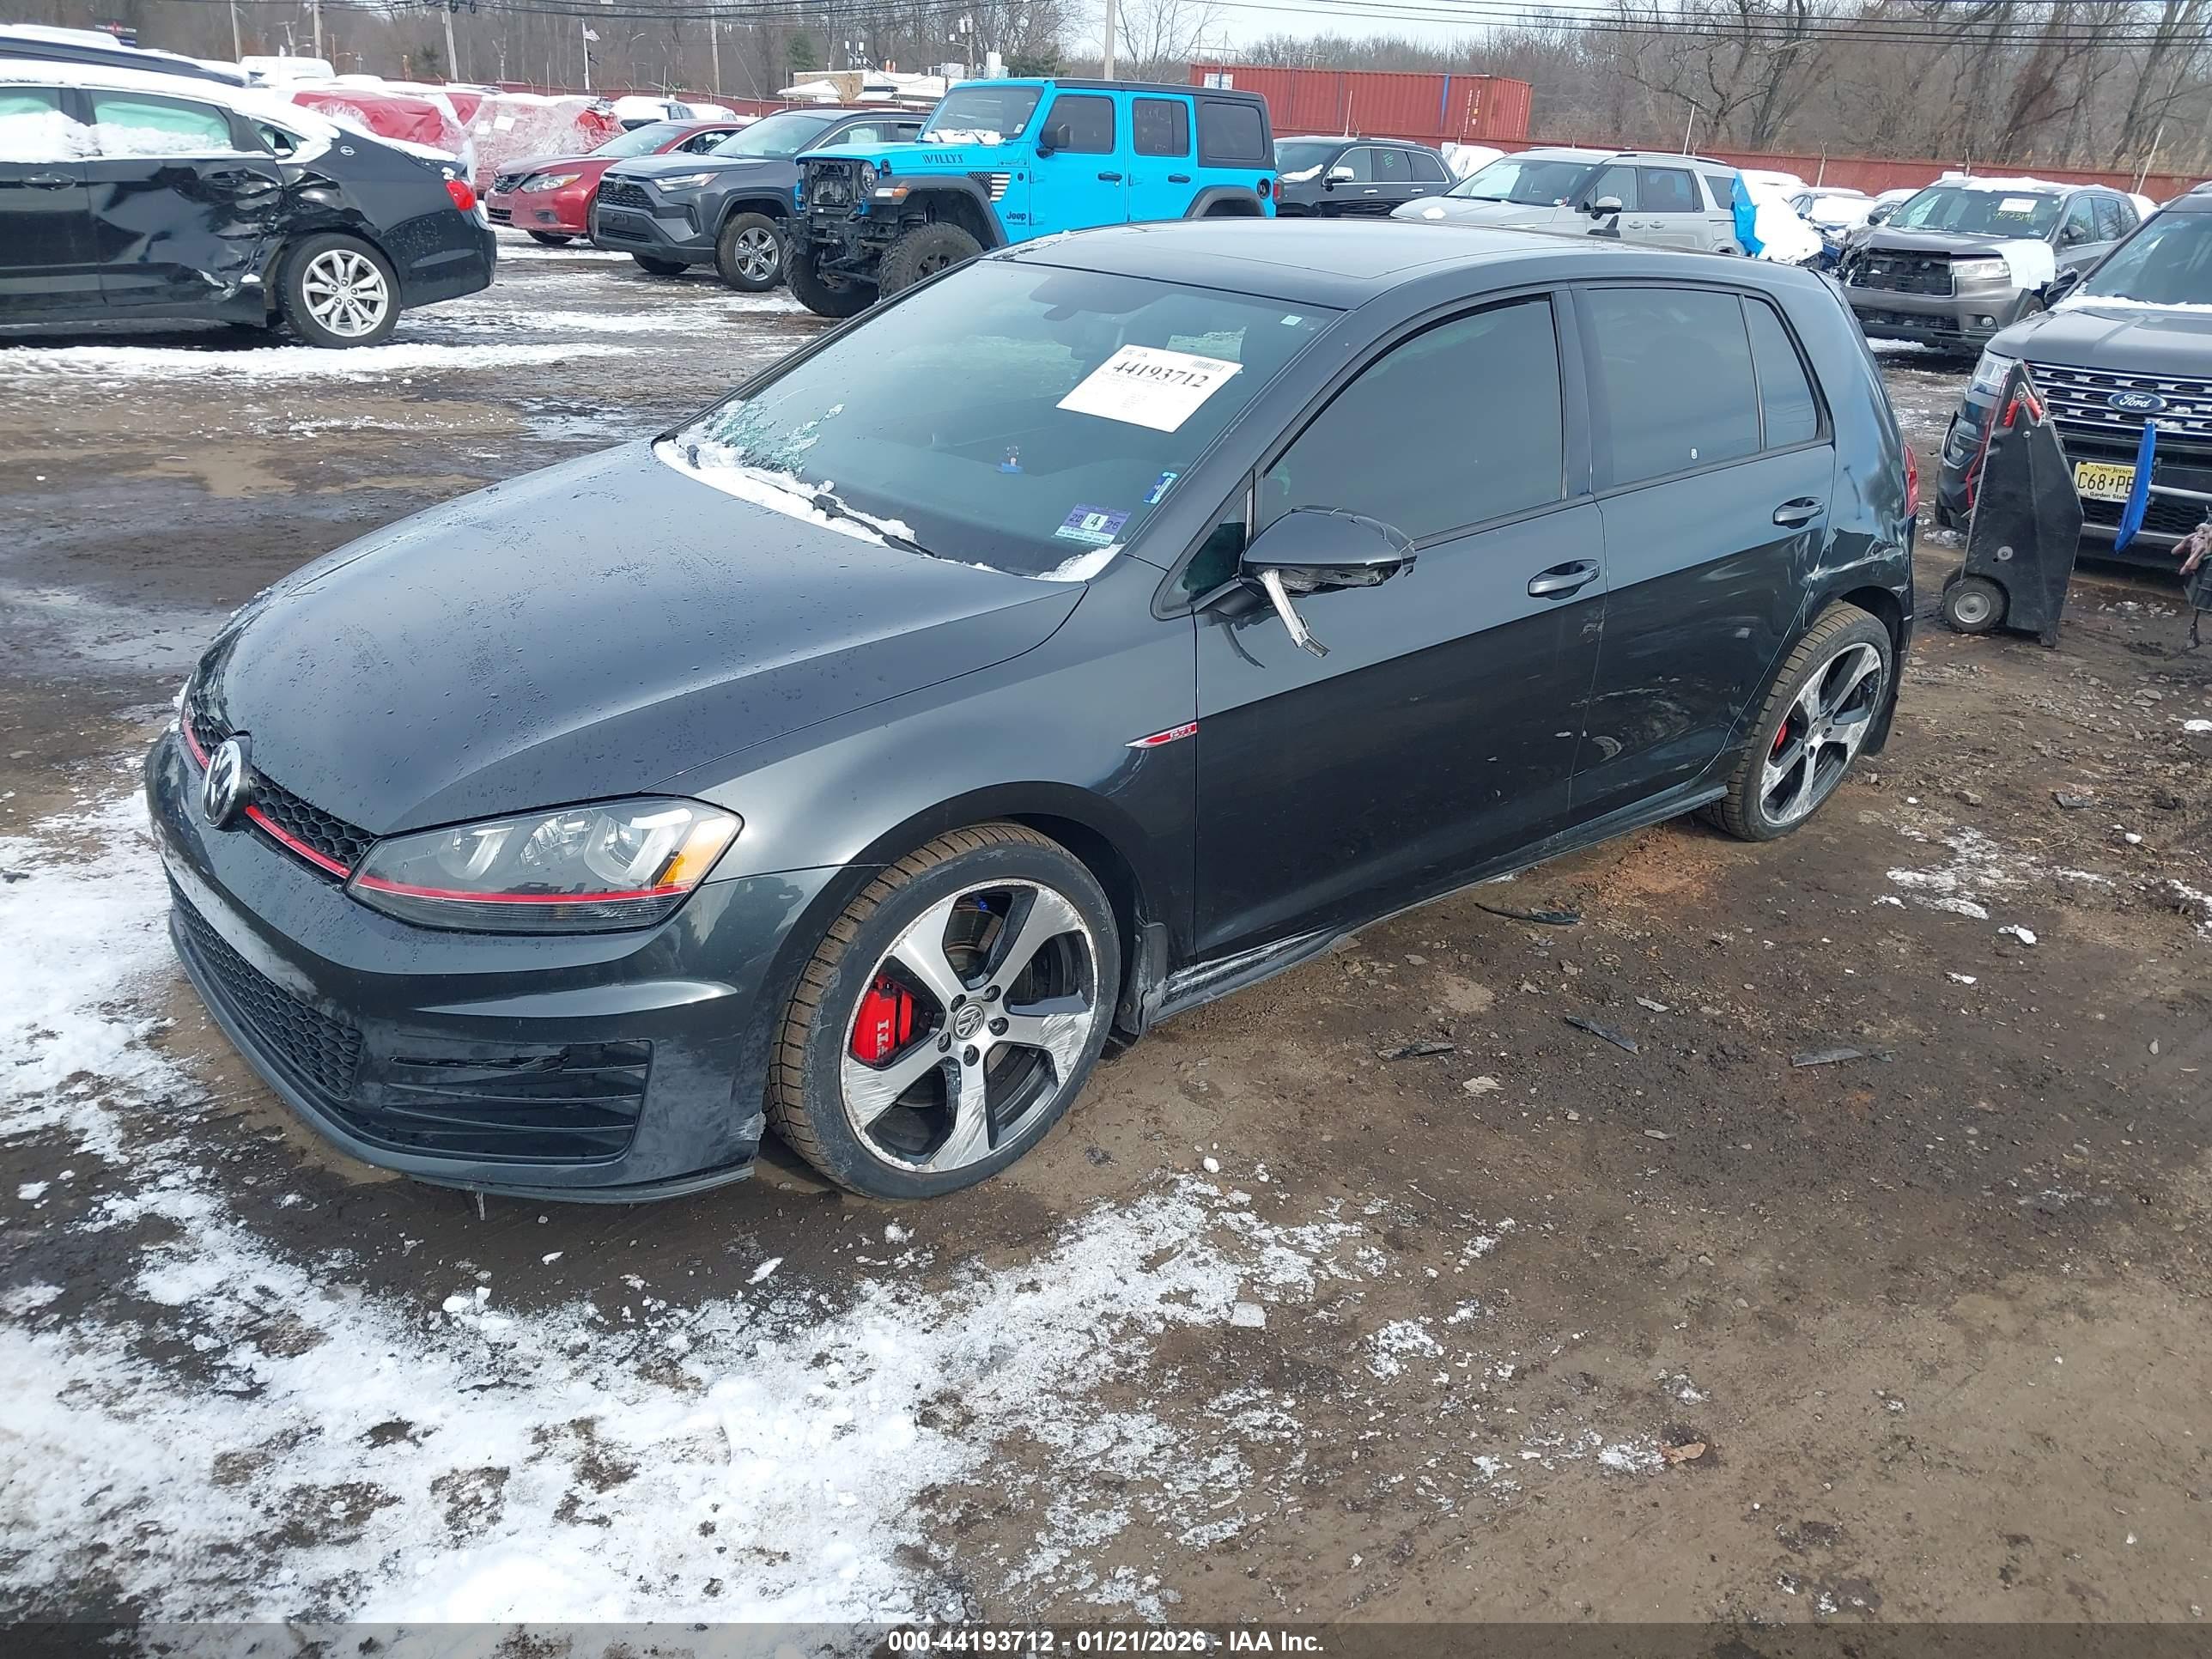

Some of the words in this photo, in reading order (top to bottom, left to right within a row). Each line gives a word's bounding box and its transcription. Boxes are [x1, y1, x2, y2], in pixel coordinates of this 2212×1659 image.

[922, 154, 963, 163] WILLYS
[1006, 210, 1026, 222] Jeep
[1113, 361, 1209, 387] 44193712
[2118, 393, 2151, 408] Ford
[2078, 471, 2106, 490] C68
[1091, 515, 1101, 527] 4
[1105, 520, 1120, 530] 26
